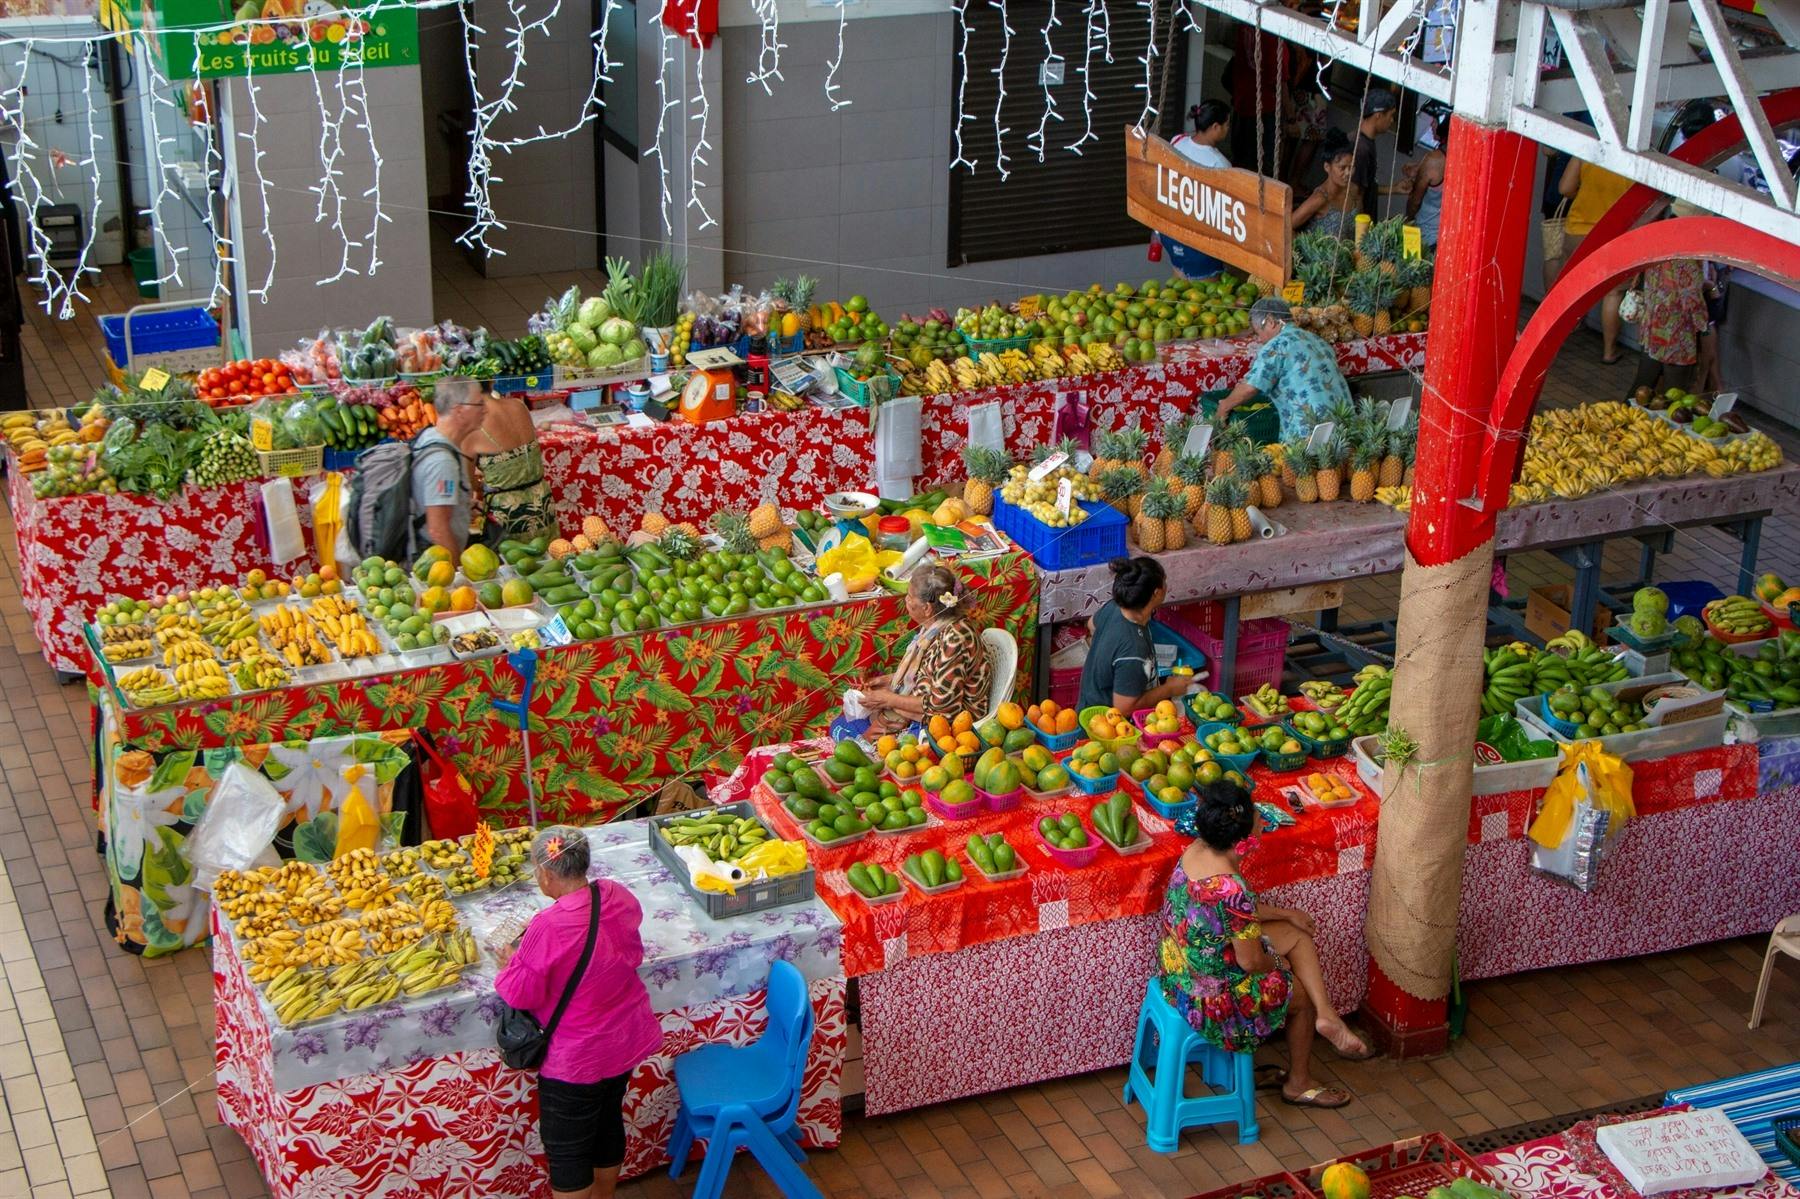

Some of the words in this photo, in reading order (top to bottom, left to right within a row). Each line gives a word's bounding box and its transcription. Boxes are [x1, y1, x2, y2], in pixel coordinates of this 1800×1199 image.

[198, 53, 234, 71] Les
[241, 49, 299, 67] fruits
[306, 46, 330, 64] du
[338, 42, 389, 62] soleil
[1156, 163, 1247, 243] LEGUMES
